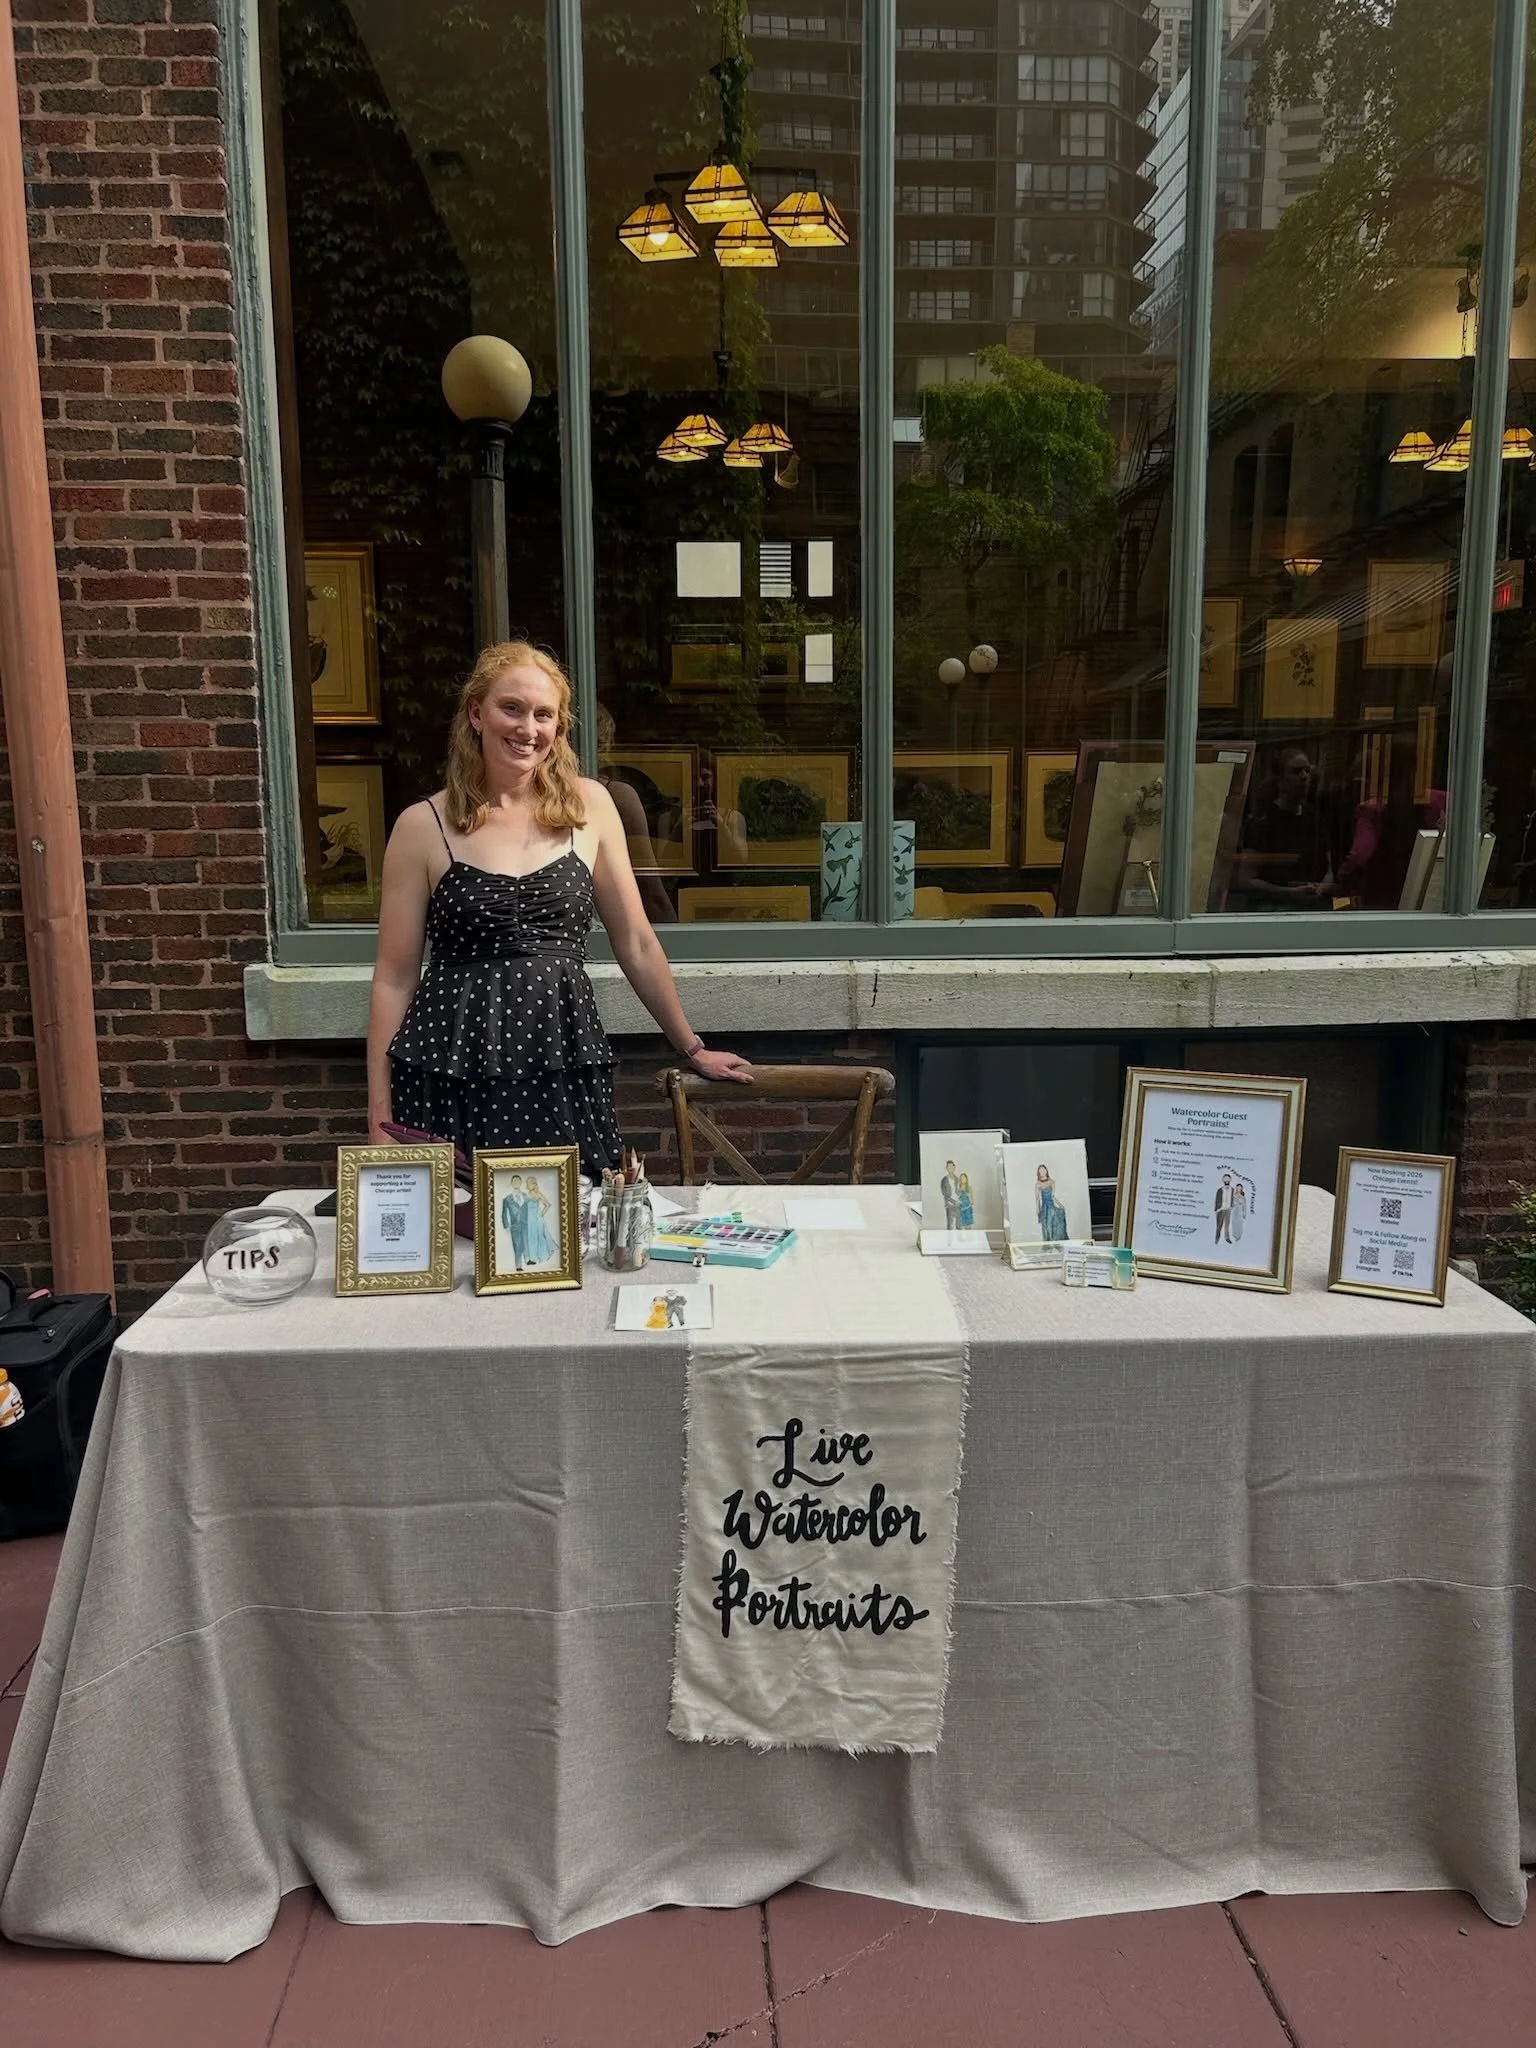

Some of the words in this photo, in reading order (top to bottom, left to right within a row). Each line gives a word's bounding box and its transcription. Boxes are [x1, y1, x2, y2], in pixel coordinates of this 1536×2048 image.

[1171, 1107, 1221, 1118] Watercolor
[1222, 1111, 1248, 1120] Guest
[1187, 1118, 1229, 1128] Portraits!
[1372, 1175, 1396, 1183] Chicago
[1382, 1168, 1405, 1177] Booking
[1353, 1228, 1362, 1236] Tag
[1380, 1231, 1399, 1239] Follow
[1401, 1234, 1418, 1242] Along
[223, 1245, 280, 1270] TIPS
[756, 1417, 873, 1489] Live
[722, 1483, 927, 1550] Watercolor
[712, 1549, 930, 1638] Portraits
